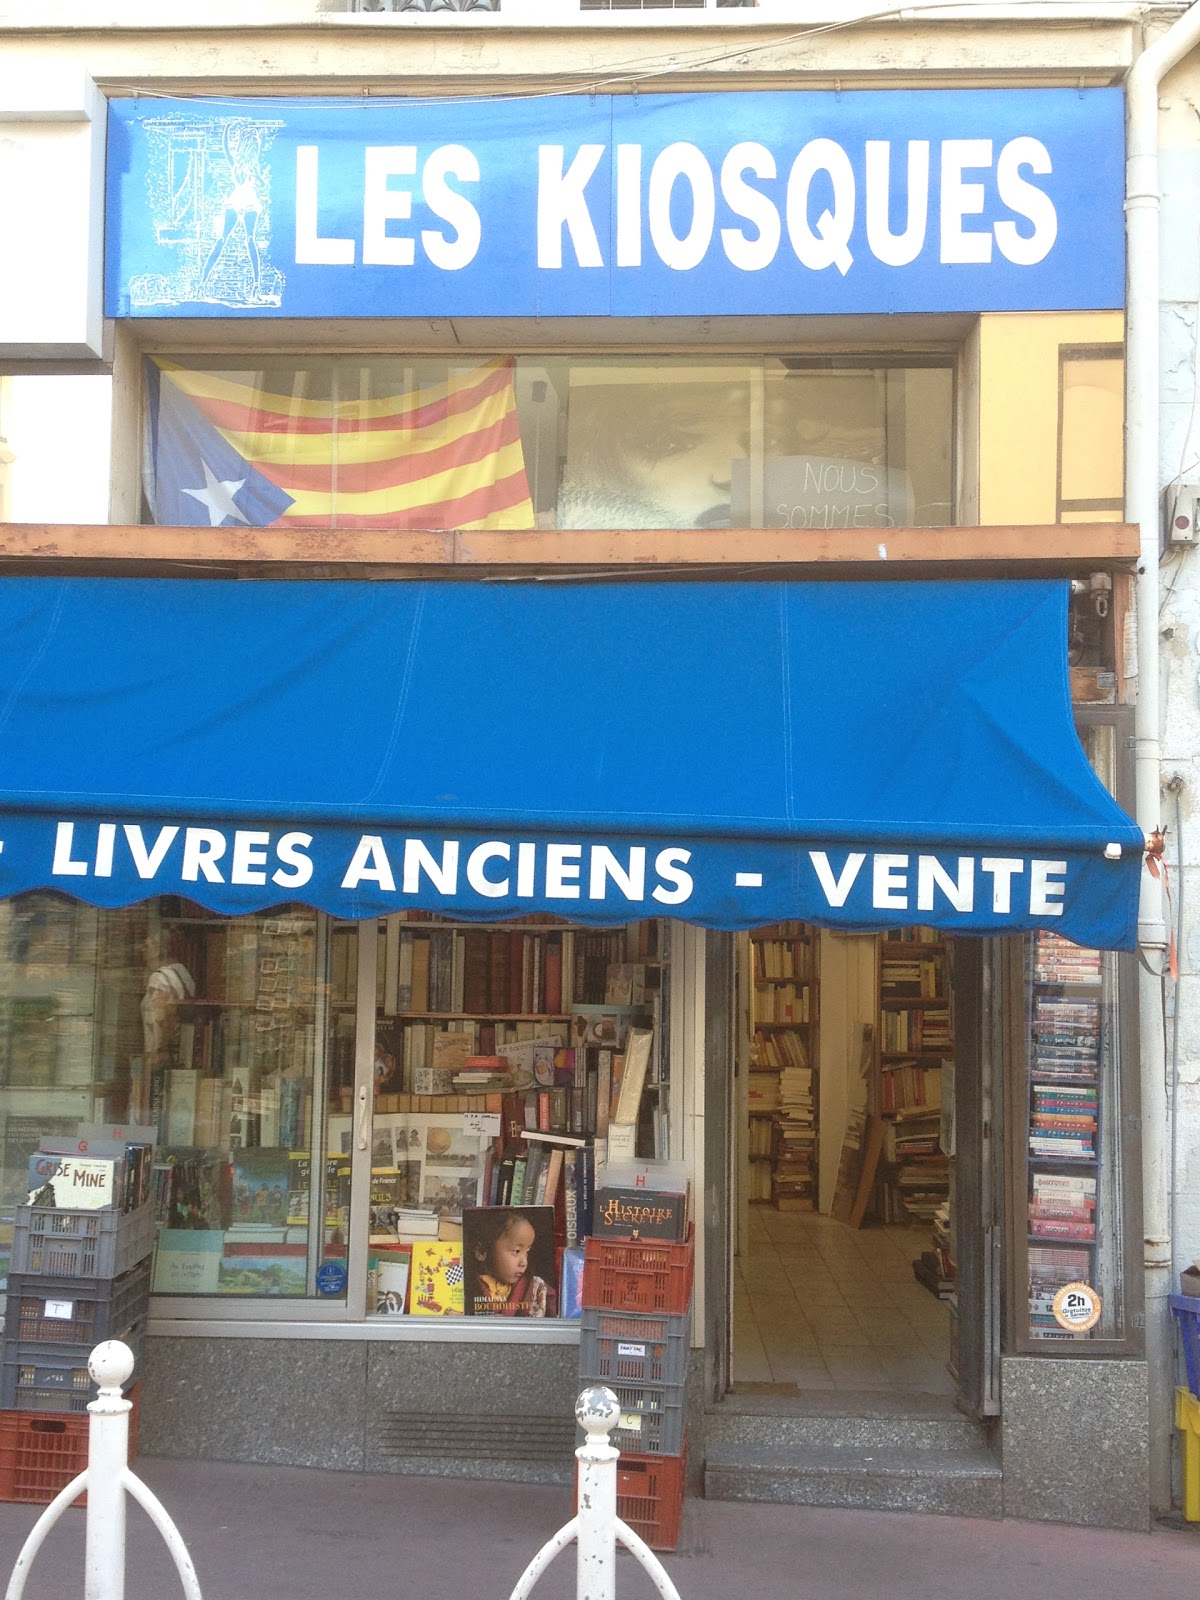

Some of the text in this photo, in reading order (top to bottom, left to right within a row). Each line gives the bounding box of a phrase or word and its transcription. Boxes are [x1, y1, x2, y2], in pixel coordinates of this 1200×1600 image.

[295, 136, 1057, 276] LES KIOSQUES
[803, 462, 879, 494] NOUS
[777, 503, 895, 529] SOMMES
[52, 821, 314, 889] LIVRES
[340, 834, 694, 905] ANCIENS
[808, 850, 1067, 917] VENTE
[78, 1140, 88, 1152] G
[72, 1169, 106, 1188] MINE
[636, 1175, 646, 1187] H
[565, 1190, 577, 1240] OISEAUX
[599, 1199, 673, 1220] L'HISTOIRE
[52, 1303, 64, 1314] T
[473, 1302, 532, 1312] BOUDDHISTE
[1067, 1293, 1085, 1307] 2h
[626, 1414, 633, 1425] C
